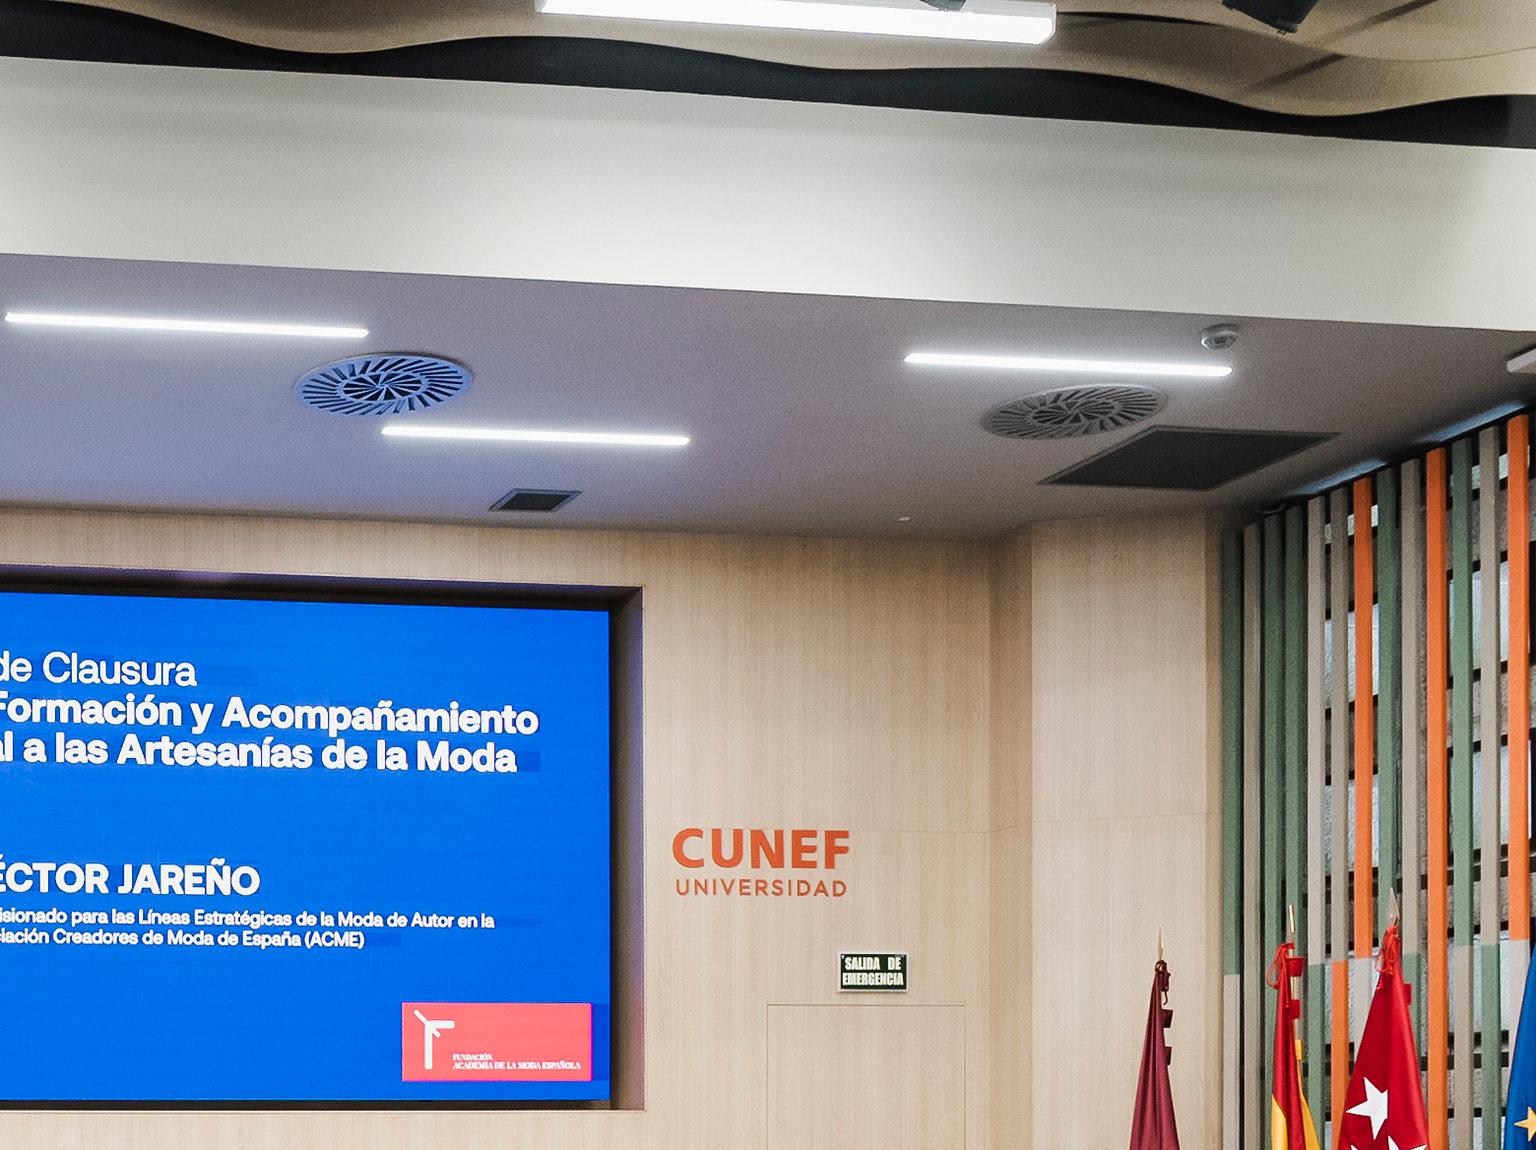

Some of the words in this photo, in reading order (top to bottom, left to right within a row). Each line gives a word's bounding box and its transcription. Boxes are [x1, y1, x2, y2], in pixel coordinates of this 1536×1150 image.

[42, 651, 198, 687] Clausura
[190, 702, 214, 735] y
[221, 696, 539, 737] Acompañamiento
[23, 738, 48, 763] a
[55, 731, 109, 764] las
[116, 733, 313, 769] Artesanías
[321, 738, 368, 770] de
[376, 739, 409, 771] la
[416, 739, 518, 773] Moda
[672, 827, 850, 870] CUNEF
[117, 857, 261, 896] JAREÑO
[675, 878, 848, 898] UNIVERSIDAD
[71, 911, 109, 928] para
[111, 908, 136, 925] las
[138, 908, 191, 925] Líneas
[194, 908, 293, 930] Estratégicas
[296, 910, 318, 927] de
[320, 911, 336, 928] la
[337, 911, 385, 928] Moda
[386, 911, 409, 928] de
[410, 911, 455, 928] Autor
[457, 915, 479, 929] en
[480, 912, 496, 929] la
[52, 927, 139, 945] Creadores
[141, 929, 164, 946] de
[167, 928, 215, 946] Moda
[217, 930, 239, 946] de
[242, 929, 302, 950] España
[304, 930, 365, 950] (ACME)
[844, 956, 881, 971] SALIDA
[887, 956, 902, 971] DE
[842, 972, 904, 986] EMERGENCIA
[452, 1061, 493, 1070] ACADEMIA
[494, 1061, 505, 1070] DE
[506, 1061, 517, 1070] LA
[517, 1061, 541, 1070] MODA
[541, 1060, 582, 1070] ESPAÑOLA
